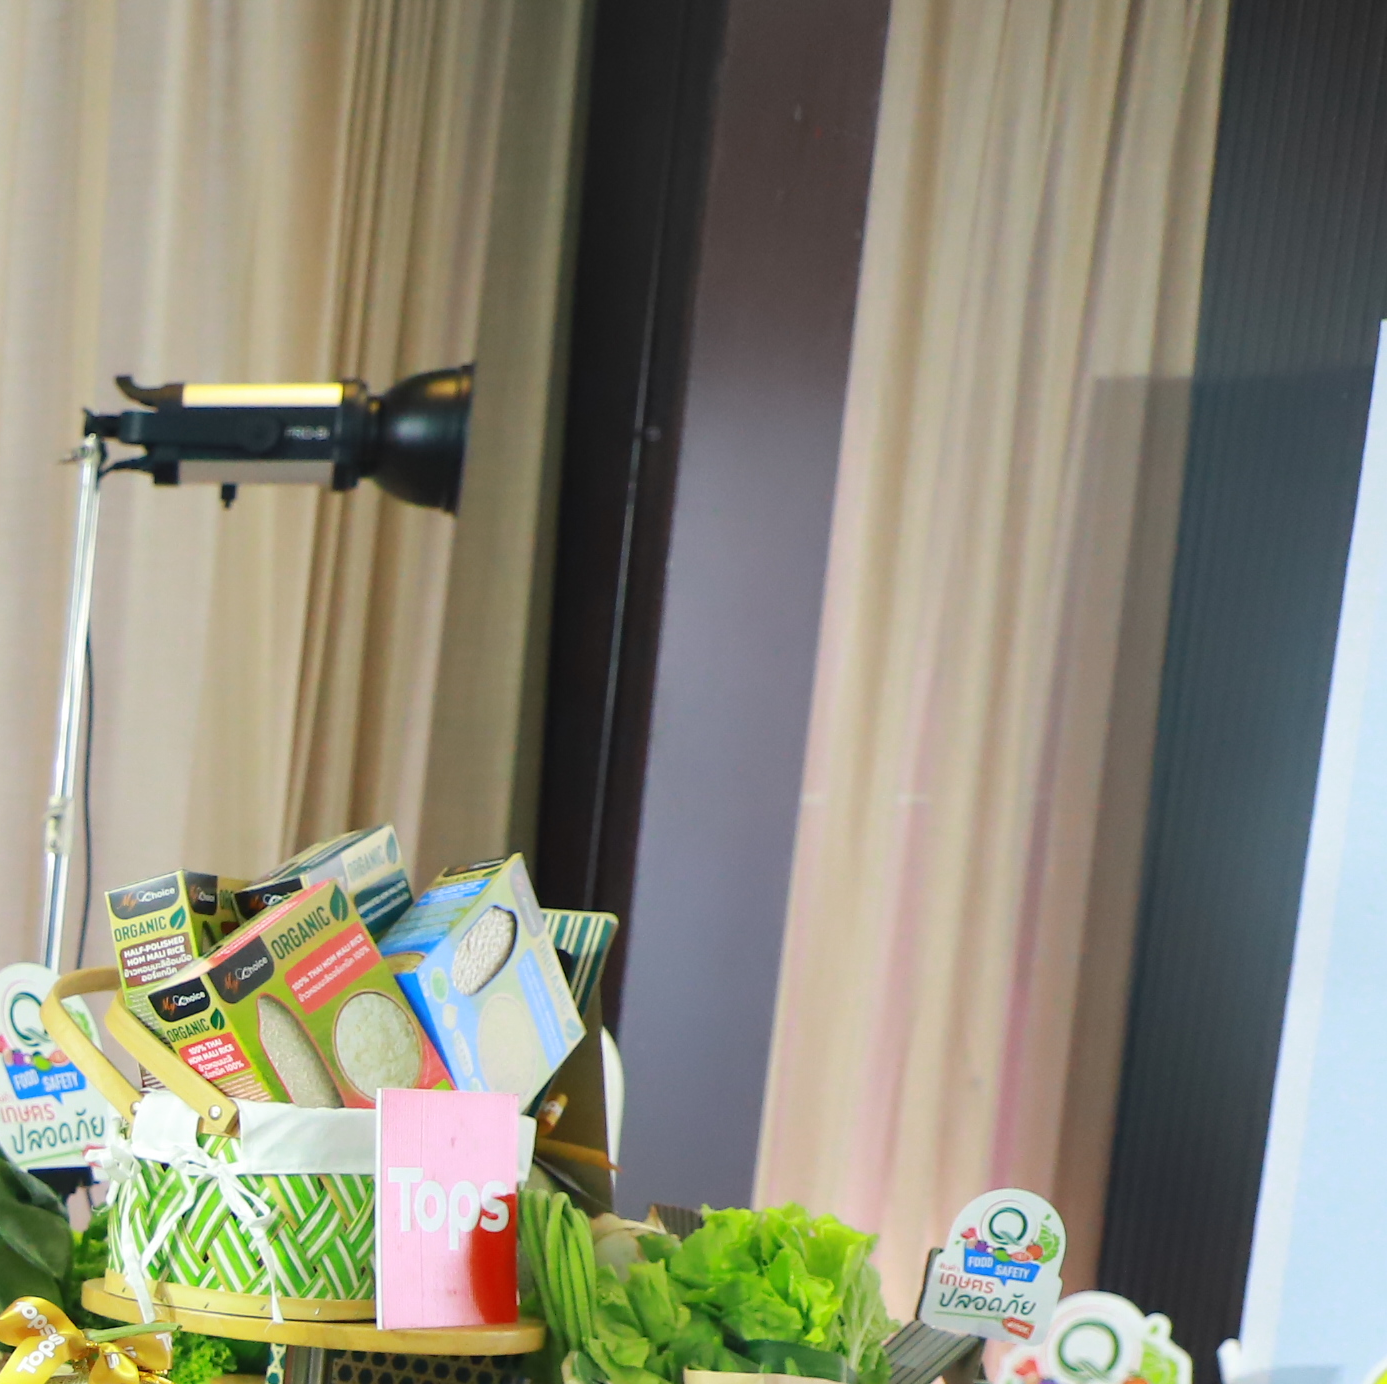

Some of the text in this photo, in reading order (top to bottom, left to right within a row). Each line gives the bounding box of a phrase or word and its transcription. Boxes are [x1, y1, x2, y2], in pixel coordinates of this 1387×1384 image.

[114, 916, 167, 943] ORGANIC
[270, 906, 331, 960] ORGANIC
[123, 935, 185, 959] HALF-POLISHED
[127, 944, 185, 967] HOM MALI RICE
[166, 1018, 210, 1043] ORGANIC
[207, 1038, 223, 1050] THAI
[218, 1043, 235, 1055] RICE
[13, 1069, 79, 1093] FOOD SAFETY
[0, 1103, 56, 1124] เกษตร
[11, 1108, 106, 1155] ปลอดภัย
[387, 1166, 510, 1251] Tops
[988, 1206, 1028, 1246] Q
[967, 1255, 1031, 1280] FOOD SAFETY
[939, 1272, 995, 1295] เกษตร
[939, 1287, 1037, 1316] ปลอดภัย
[15, 1333, 67, 1375] Tops
